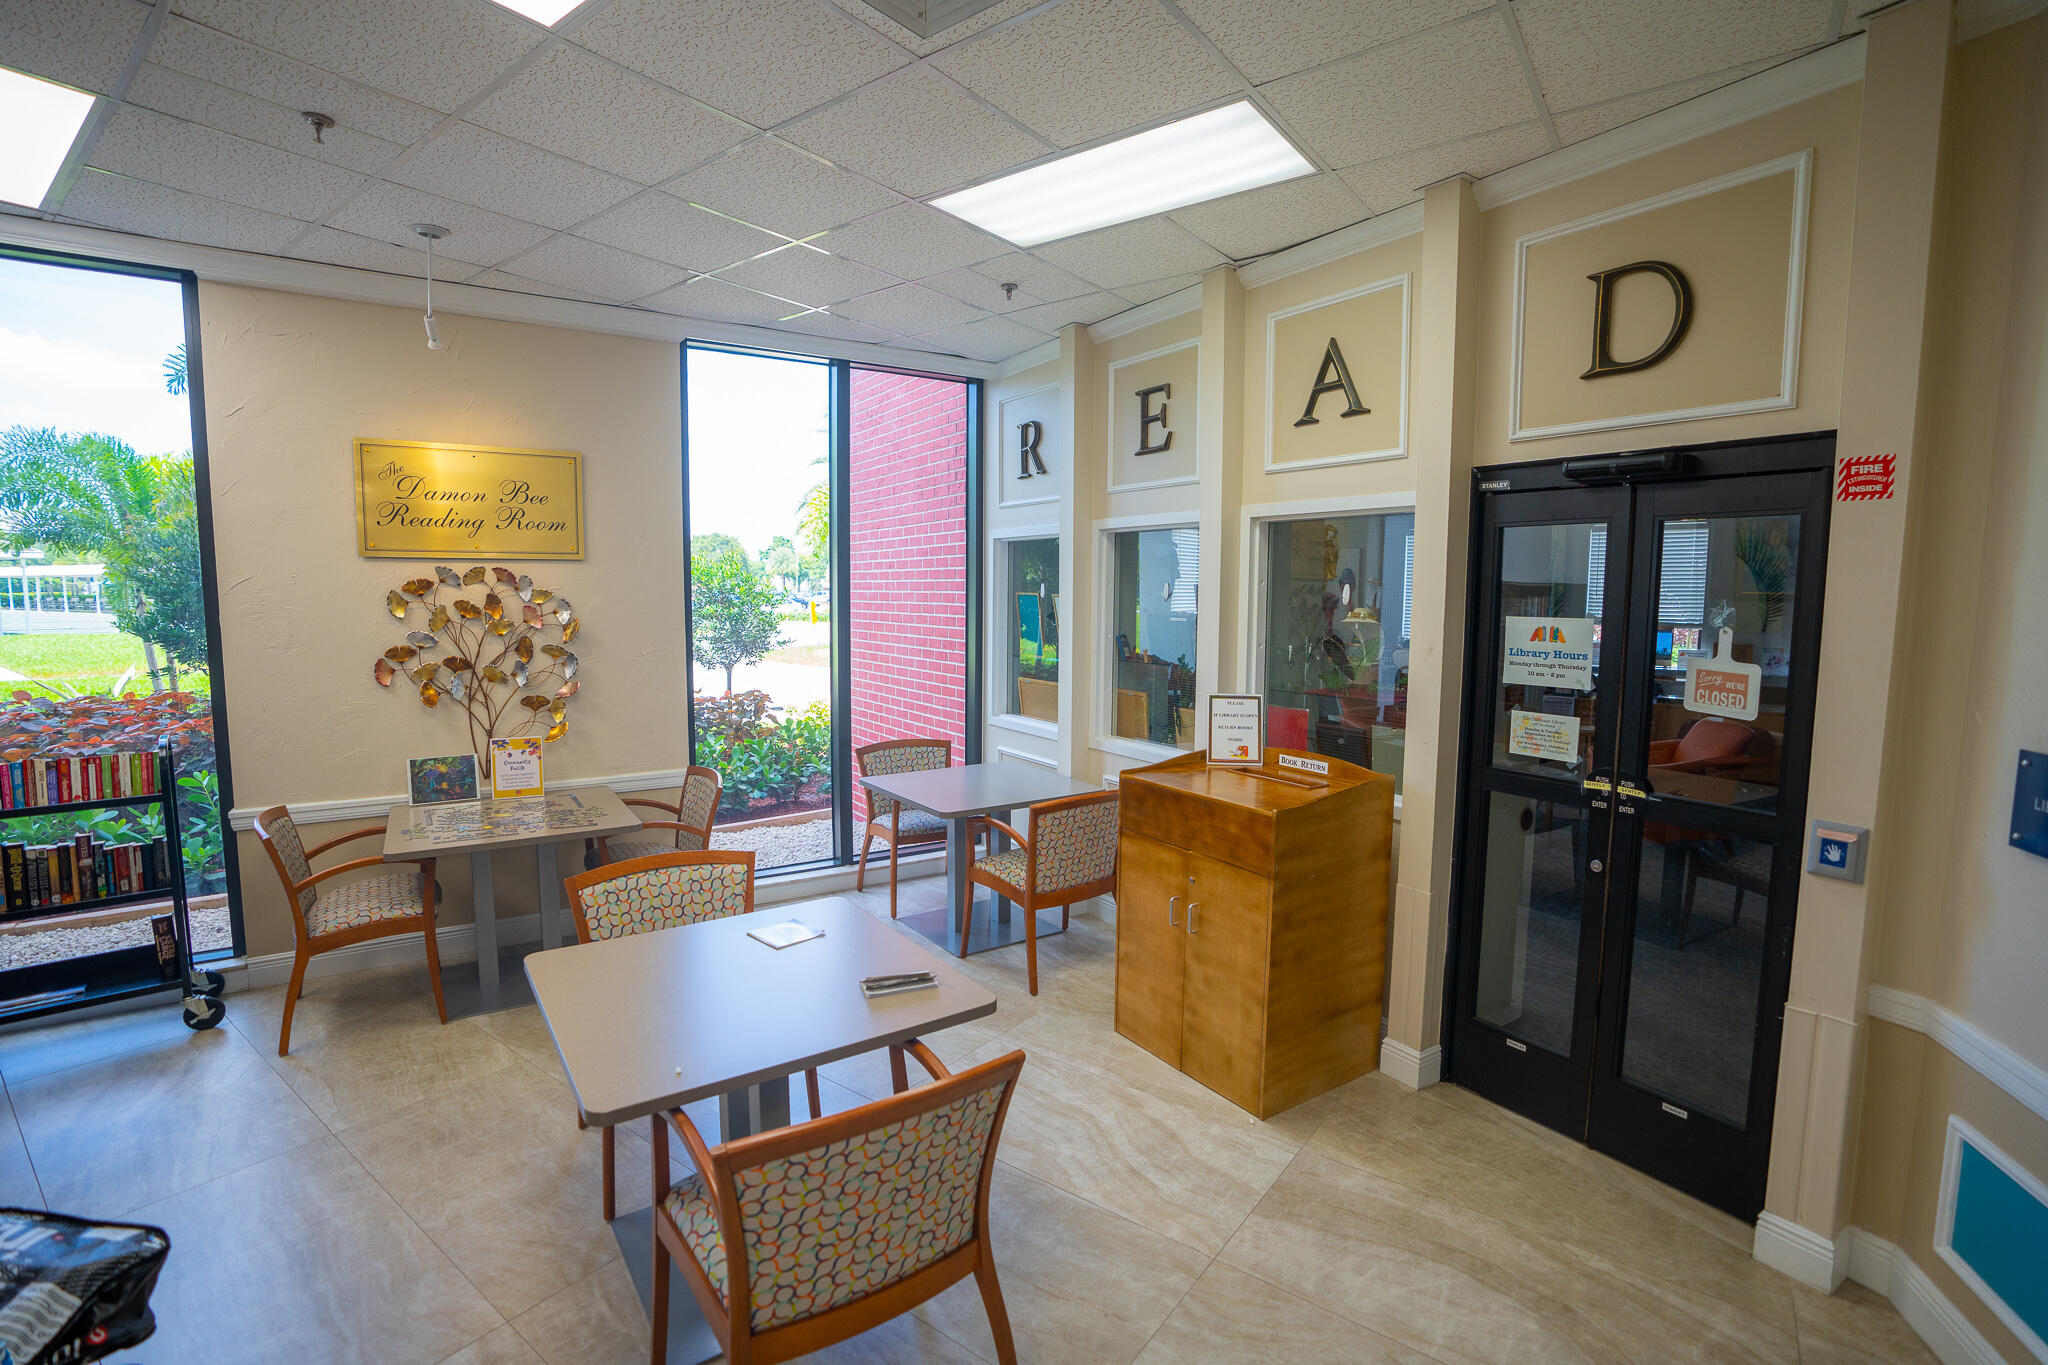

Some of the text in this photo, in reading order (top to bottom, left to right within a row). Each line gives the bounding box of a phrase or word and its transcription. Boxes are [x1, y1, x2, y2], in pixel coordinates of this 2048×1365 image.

[378, 461, 404, 481] The
[1851, 463, 1884, 474] FIRE
[1847, 474, 1888, 485] EXTINGUISHER
[392, 474, 549, 506] Damon Bee
[1848, 484, 1884, 493] INSIDE
[376, 501, 568, 539] Reading Room
[1508, 647, 1588, 661] Library Hours
[1557, 663, 1587, 671] Thursday
[1698, 671, 1724, 685] Sorry
[1696, 689, 1745, 709] CLOSED
[1281, 756, 1326, 772] BOOK RETURN
[1620, 780, 1635, 788] PUSH
[1619, 806, 1635, 814] ENTER
